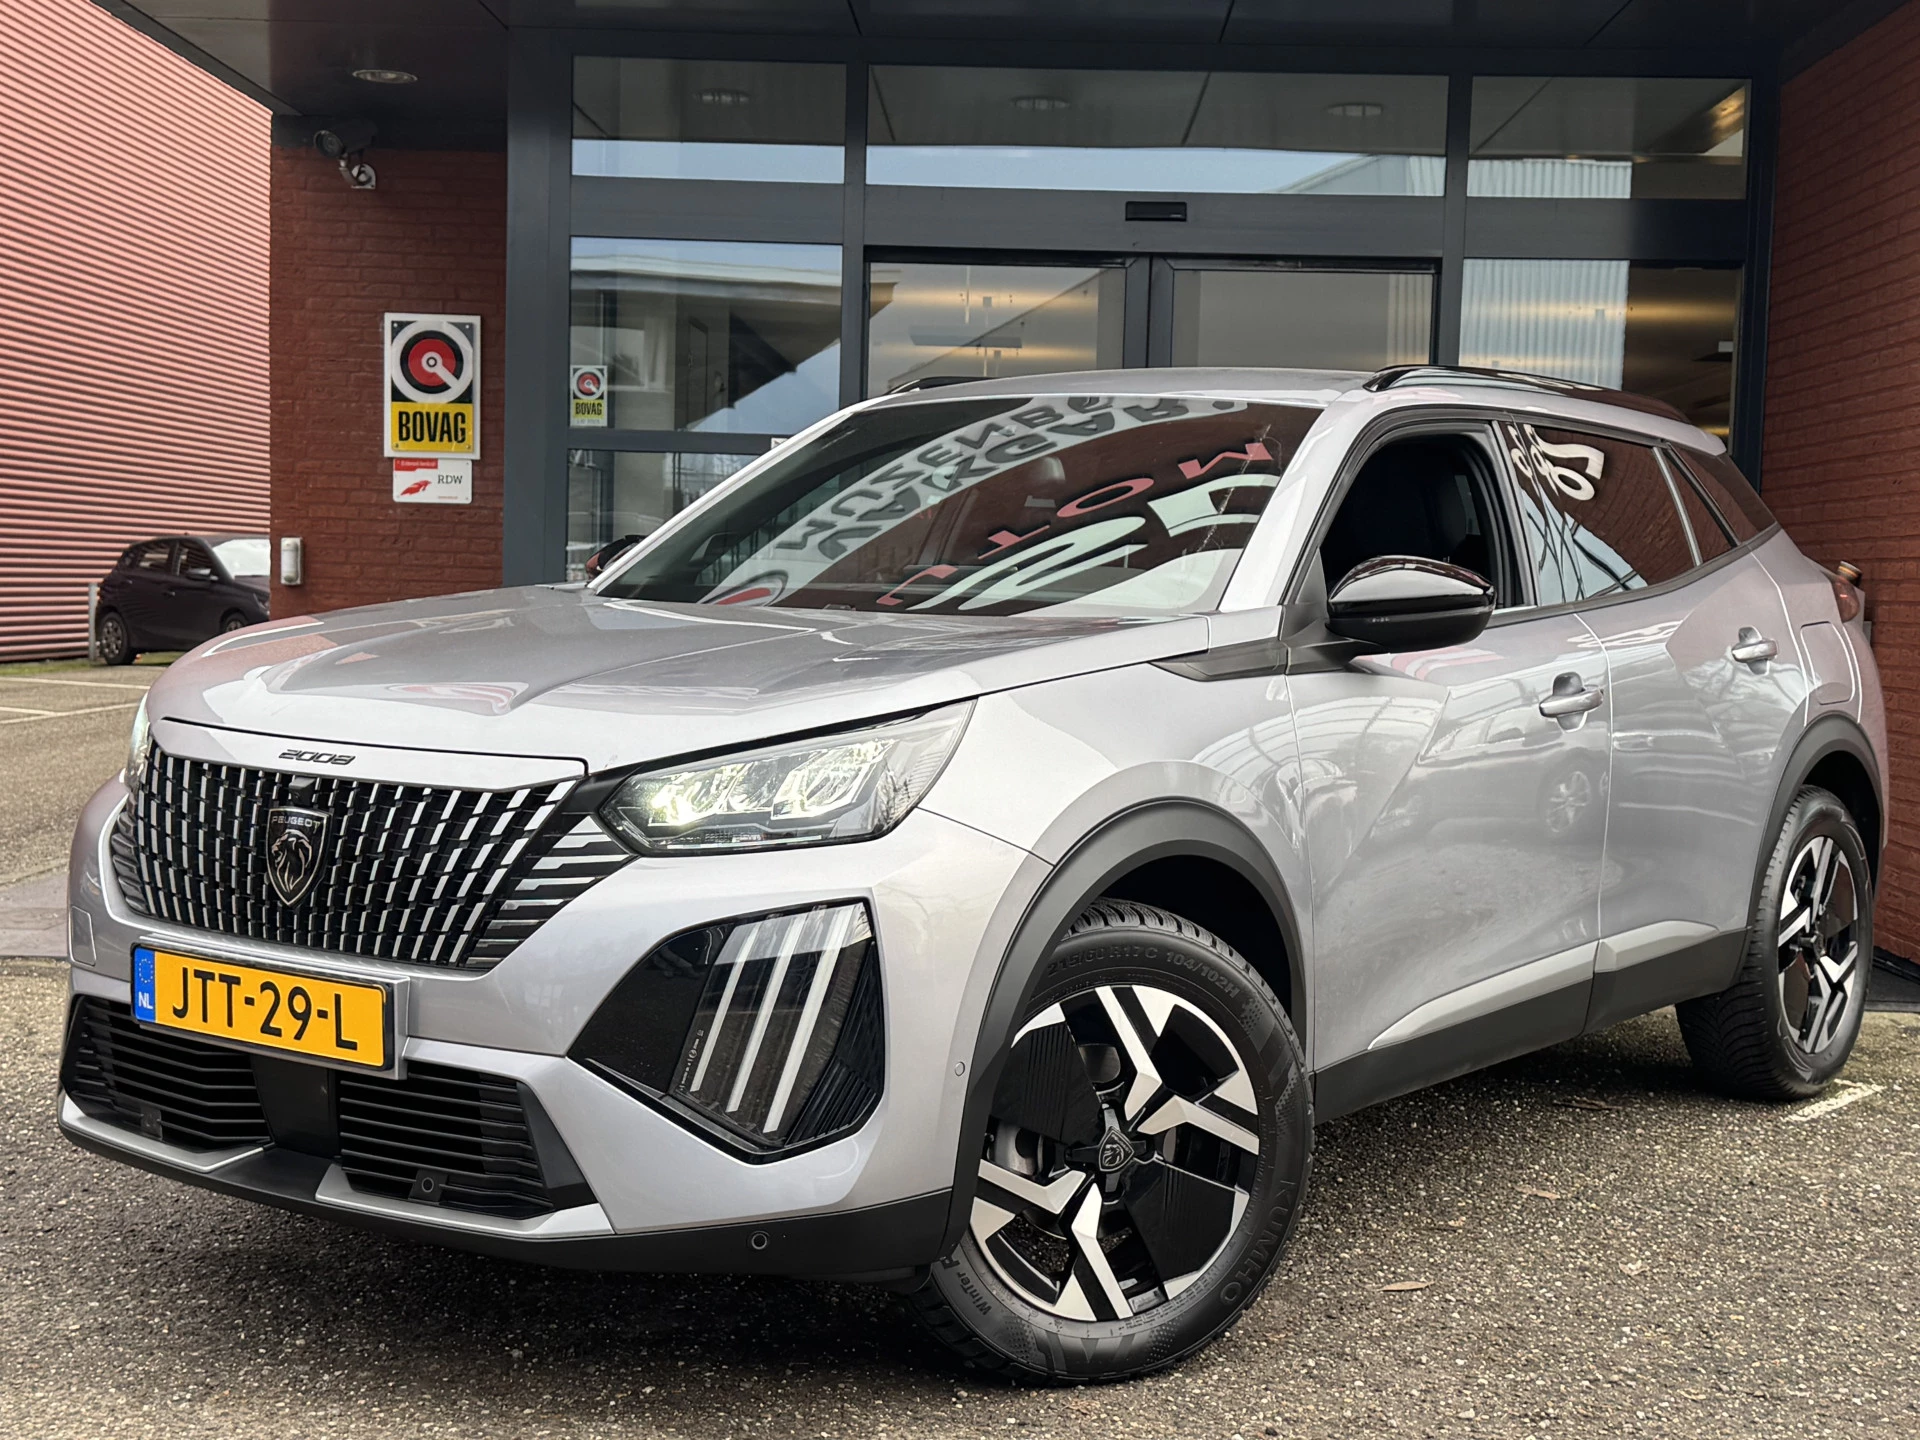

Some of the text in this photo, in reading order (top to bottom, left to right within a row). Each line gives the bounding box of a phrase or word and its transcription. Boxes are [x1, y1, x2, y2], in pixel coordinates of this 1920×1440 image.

[575, 402, 602, 416] BOVAG
[398, 410, 466, 444] BOVAG
[437, 474, 463, 484] RDW
[278, 749, 356, 766] 2008
[271, 815, 321, 834] PEUGEOT
[1165, 950, 1241, 999] 104/102H
[137, 991, 154, 1010] NL
[172, 966, 358, 1051] JTT-29-L
[1220, 1180, 1297, 1303] KUMHO
